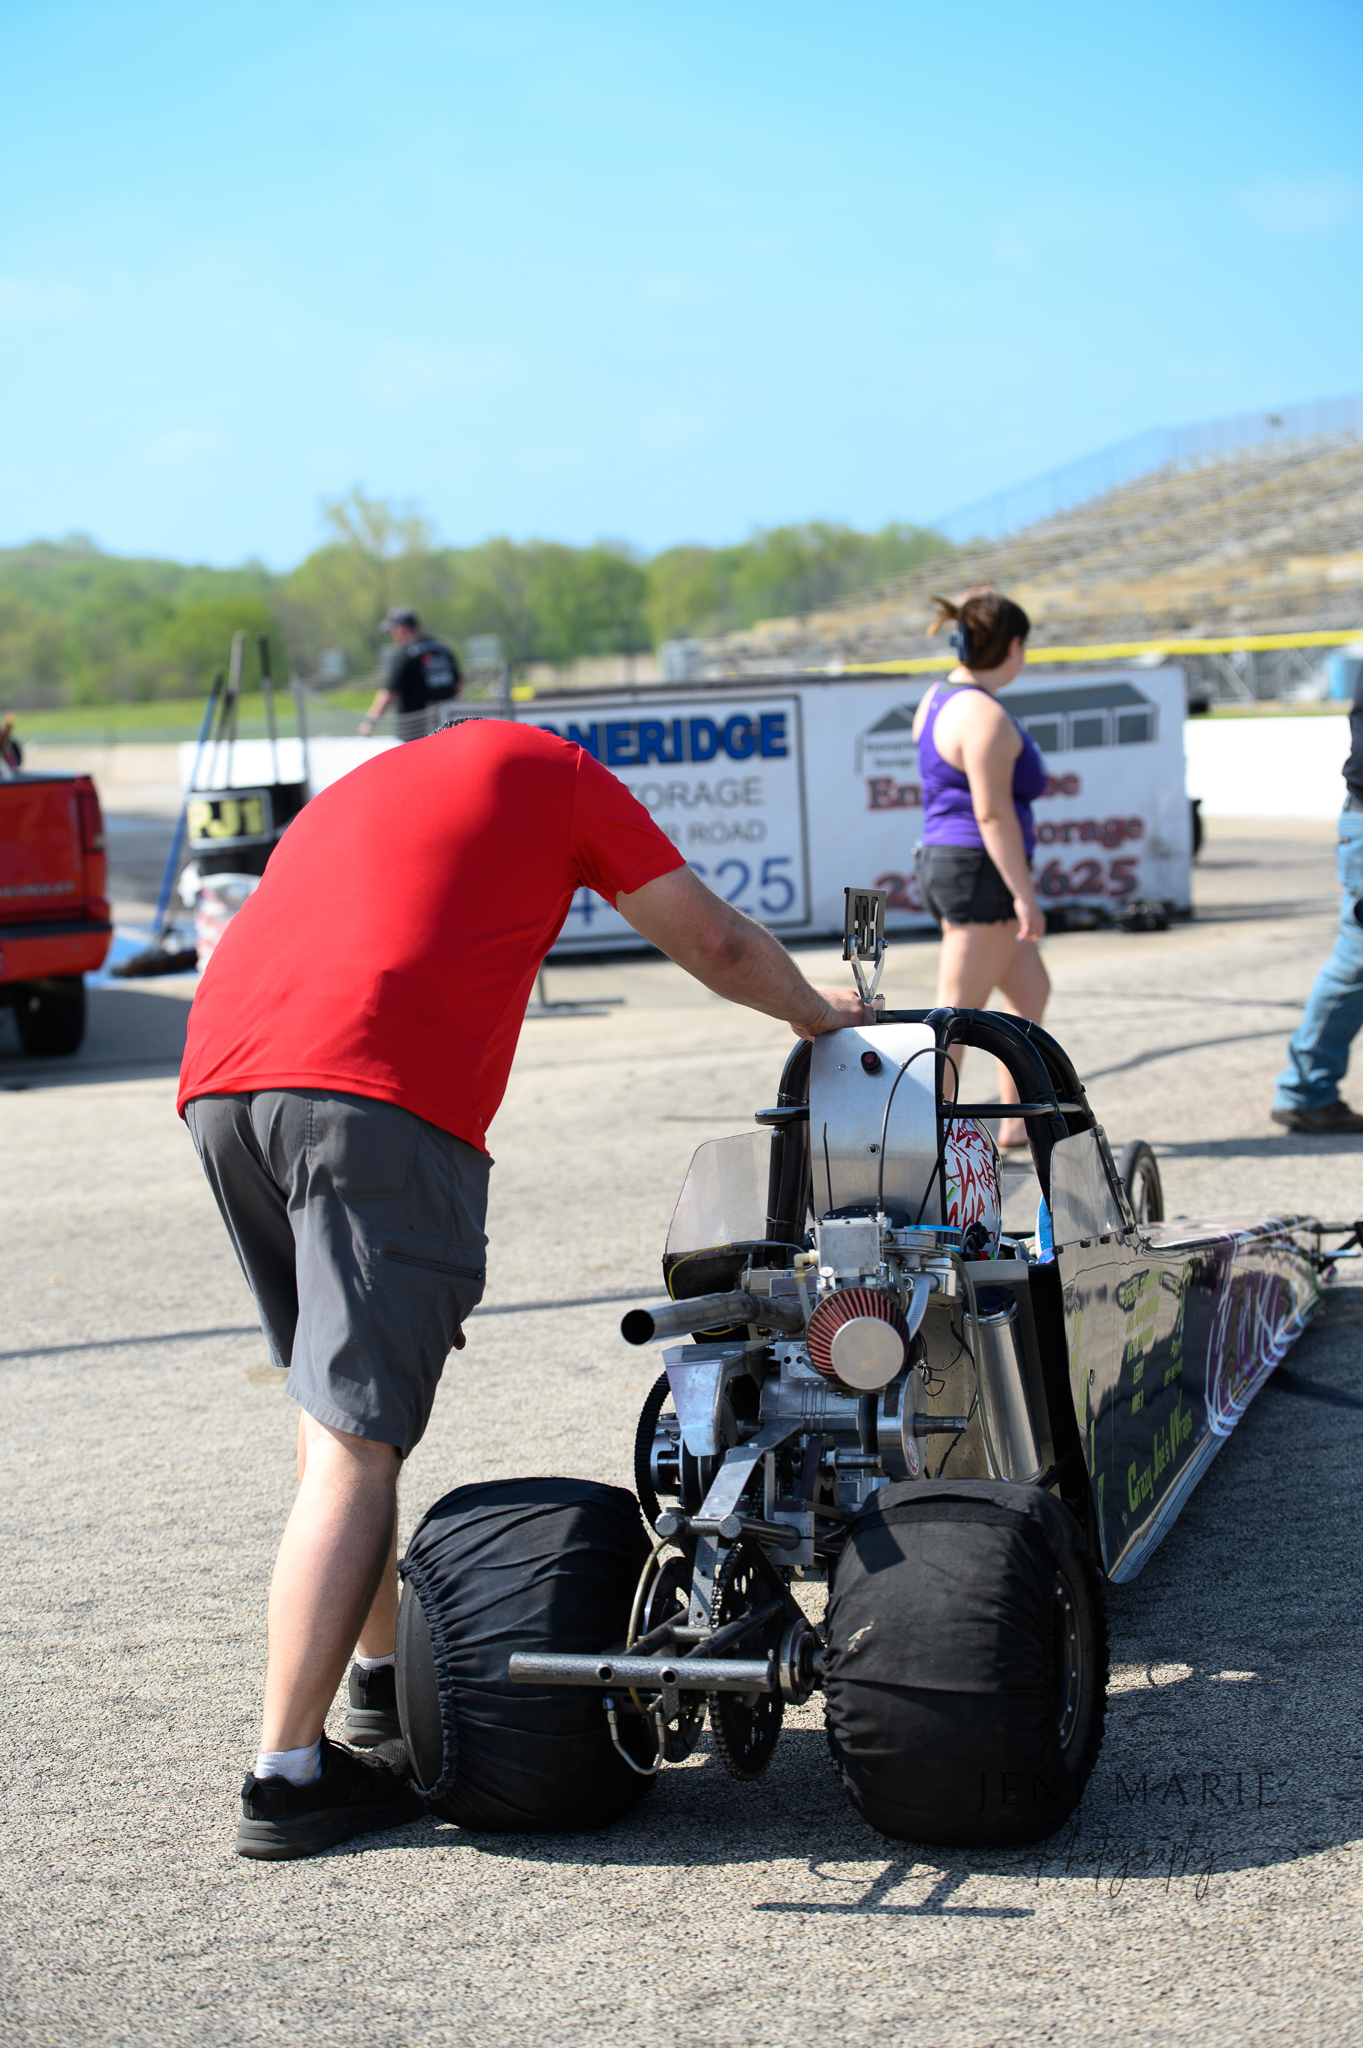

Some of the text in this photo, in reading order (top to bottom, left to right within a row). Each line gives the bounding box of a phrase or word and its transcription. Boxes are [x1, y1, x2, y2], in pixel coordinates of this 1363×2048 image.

[538, 712, 789, 767] NERIDGE
[686, 818, 768, 847] ROAD
[1034, 815, 1145, 848] orage
